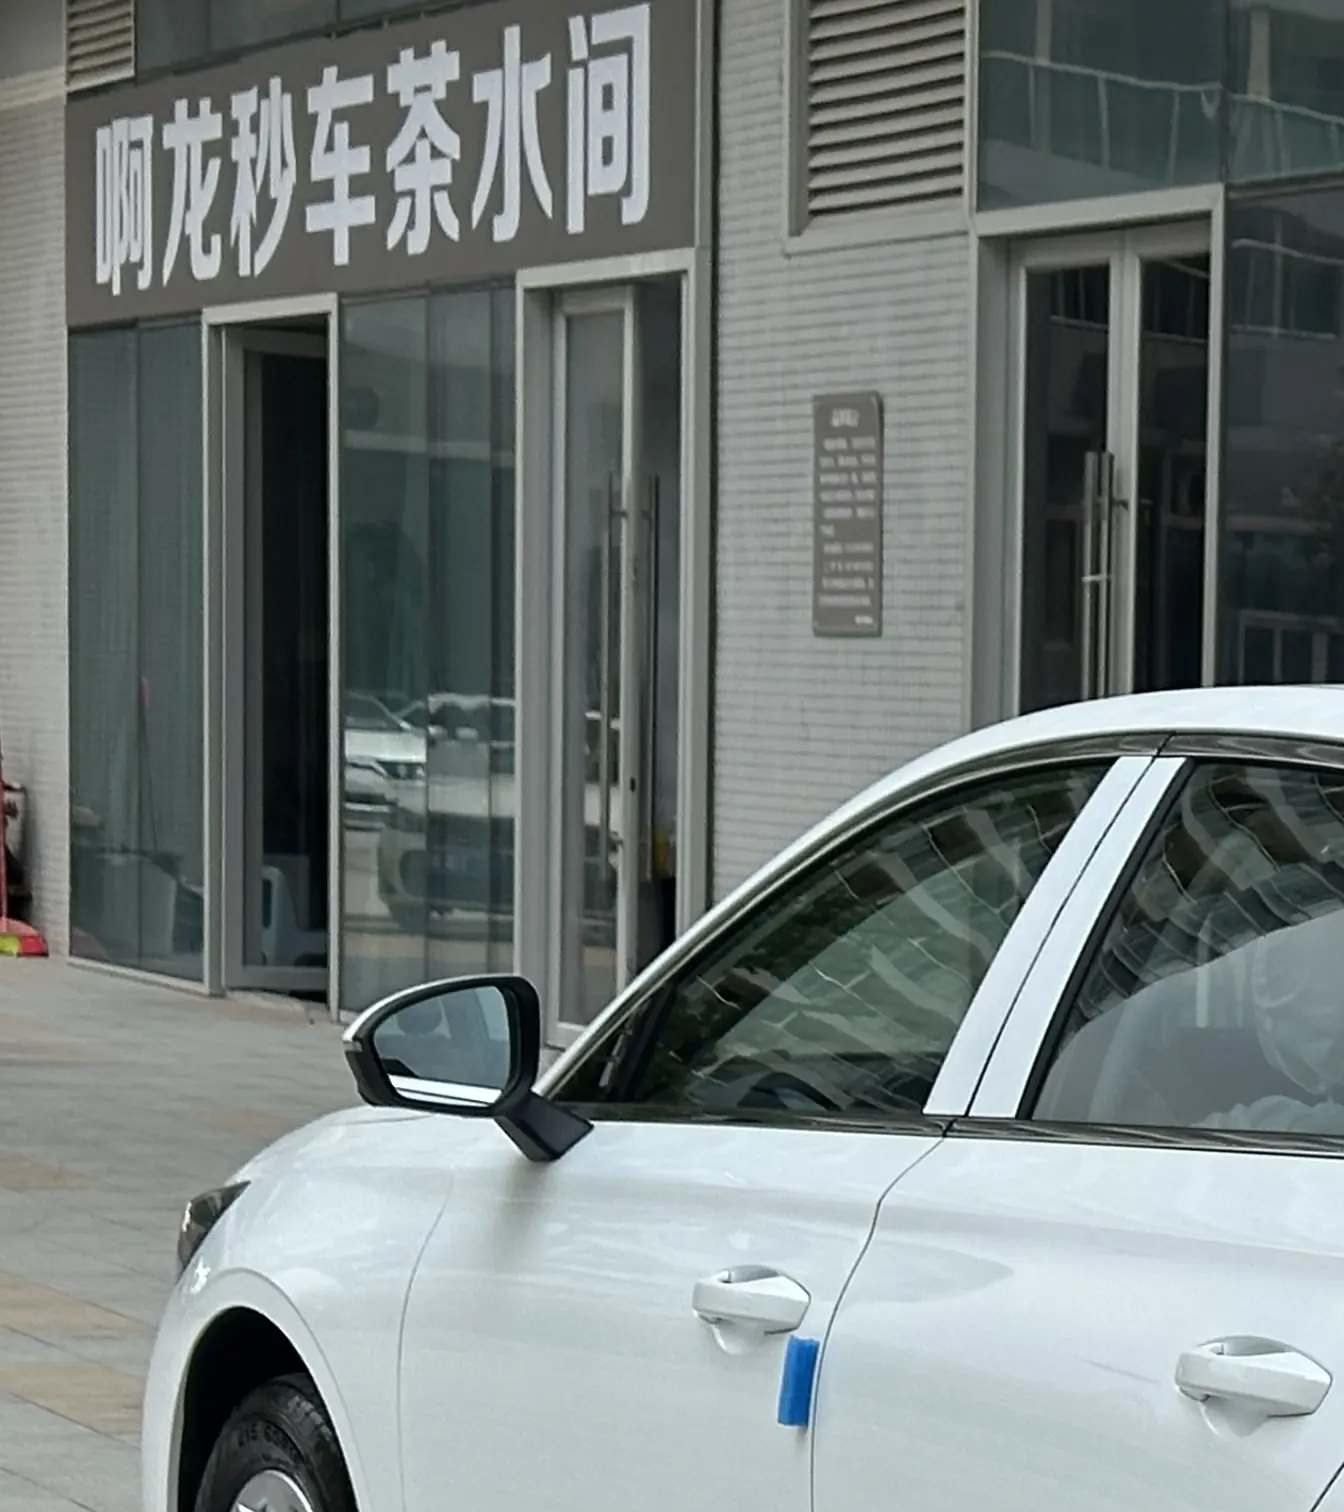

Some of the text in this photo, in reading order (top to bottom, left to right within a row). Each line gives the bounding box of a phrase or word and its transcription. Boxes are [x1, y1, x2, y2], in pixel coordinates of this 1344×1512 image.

[95, 3, 651, 296] 啊龙秒车茶水间
